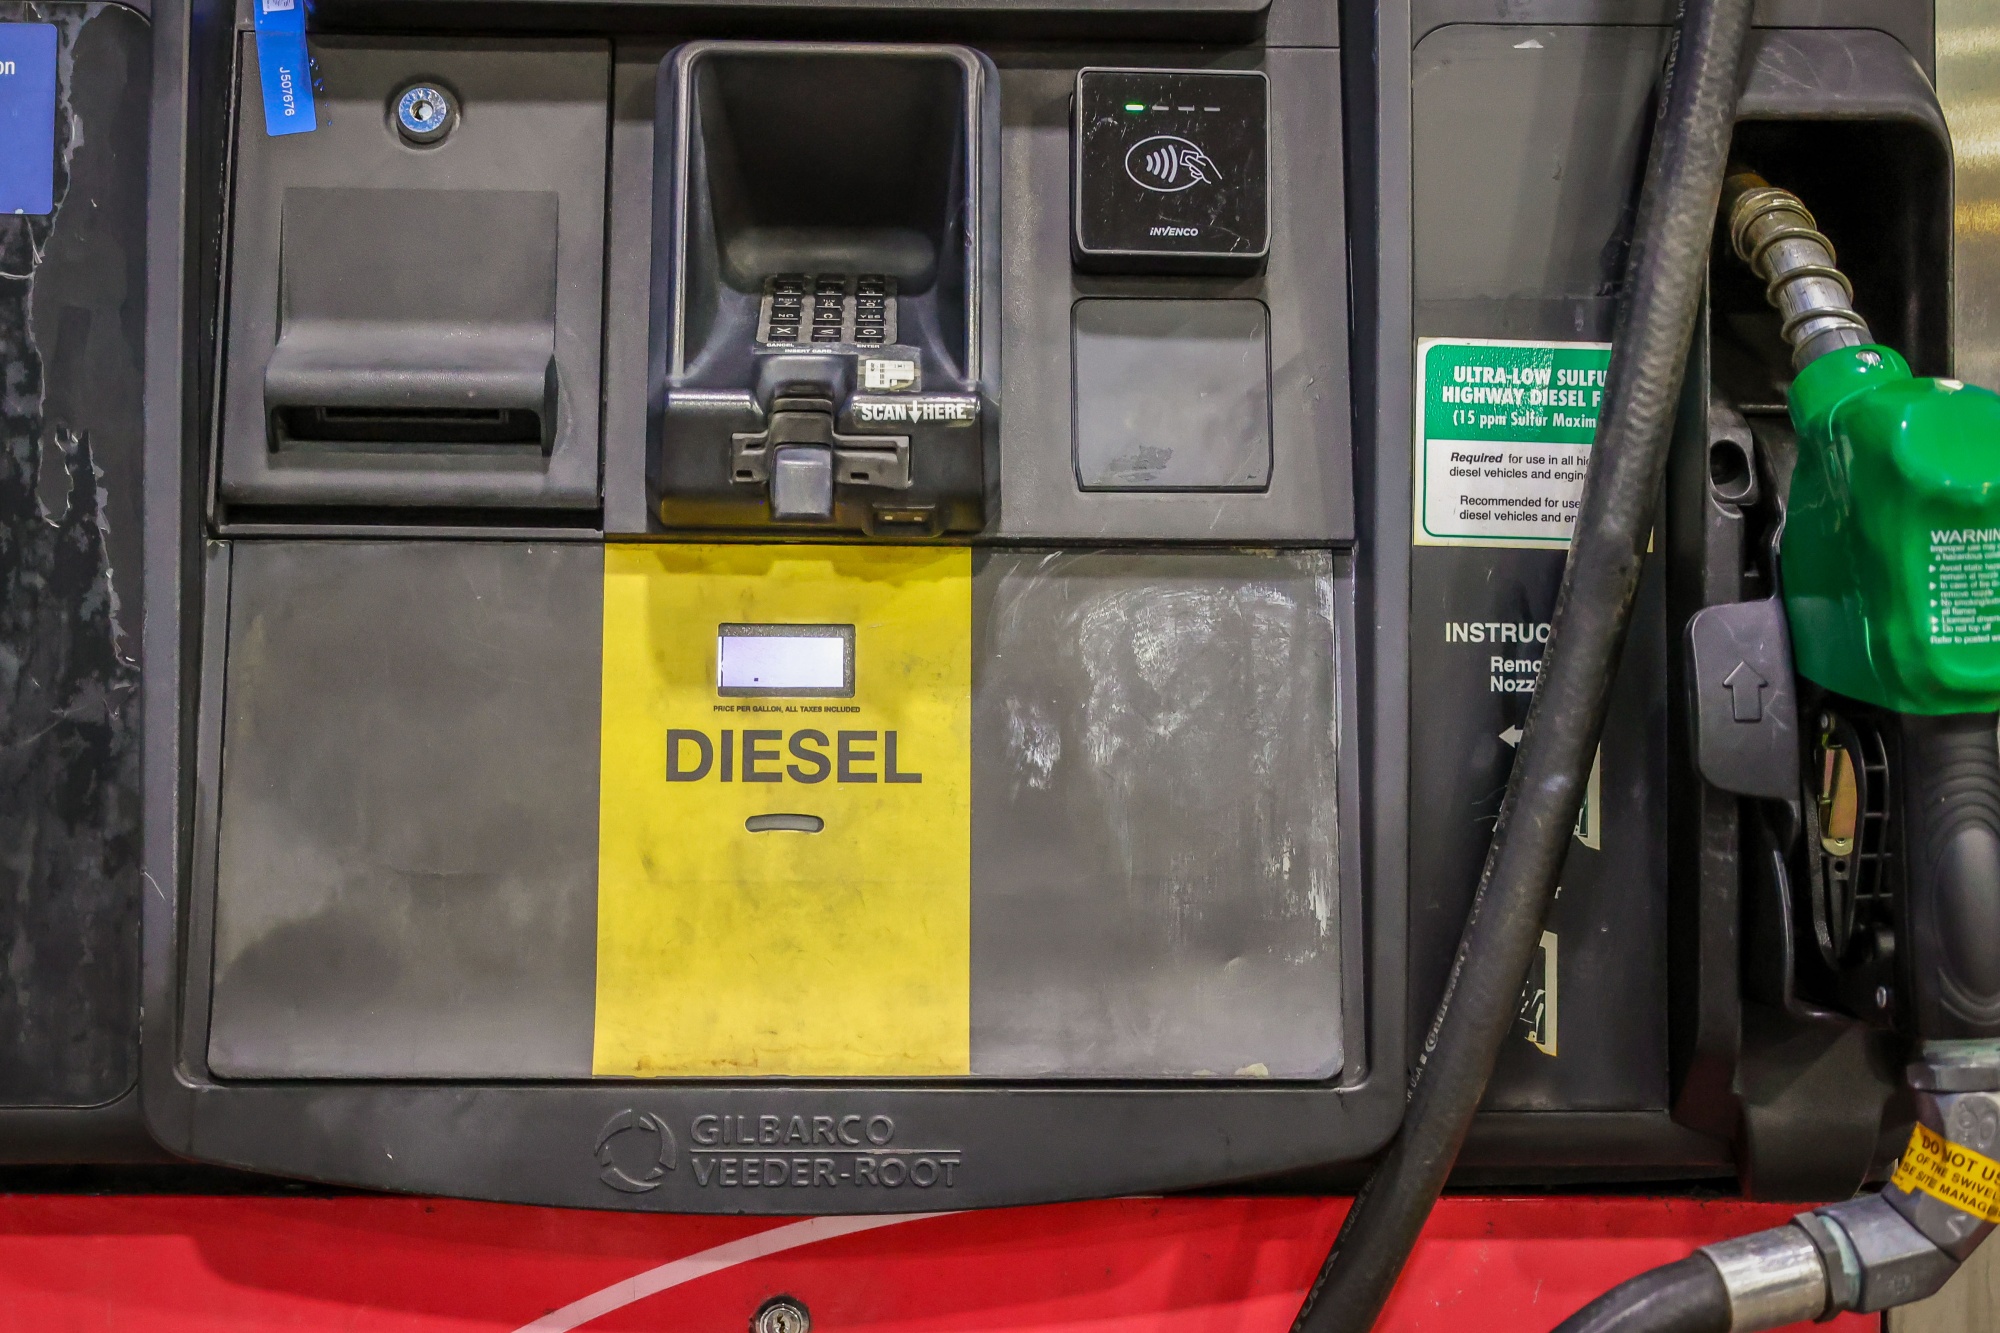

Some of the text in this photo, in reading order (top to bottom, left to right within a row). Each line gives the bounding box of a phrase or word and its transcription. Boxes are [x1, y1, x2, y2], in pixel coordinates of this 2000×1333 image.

[279, 67, 295, 116] J507676
[1453, 365, 1607, 387] ULTRA-LOW SULFU
[1442, 386, 1524, 406] HIGHWAY
[1529, 388, 1587, 407] DIESEL
[861, 403, 967, 421] SCAN HERE
[1453, 410, 1597, 429] (15 ppm Sulfur Maxim
[1450, 452, 1503, 464] Required
[1508, 453, 1523, 464] for
[1525, 455, 1546, 465] use
[1548, 455, 1558, 465] in
[1561, 455, 1574, 466] all
[1449, 467, 1586, 483] diesel vehicles and engin
[1460, 495, 1580, 509] Recommended for use
[1459, 510, 1491, 521] diesel
[1494, 511, 1538, 522] vehicles
[1541, 512, 1561, 523] and
[1930, 529, 2000, 544] WARNIN
[1445, 622, 1551, 643] INSTRUC
[1490, 675, 1538, 692] Nozz
[713, 705, 735, 713] PRICE
[736, 705, 751, 713] PER
[752, 706, 784, 714] GALLON,
[824, 706, 860, 714] INCLUDED
[665, 728, 923, 784] DIESEL
[690, 1114, 896, 1146] GILBARCO
[1921, 1135, 1940, 1155] DO
[1941, 1145, 1979, 1173] NOT
[692, 1157, 962, 1187] VEEDER-ROOT
[1916, 1152, 1931, 1165] OF
[1930, 1160, 1948, 1178] THE
[1939, 1183, 2000, 1218] MANAGE
